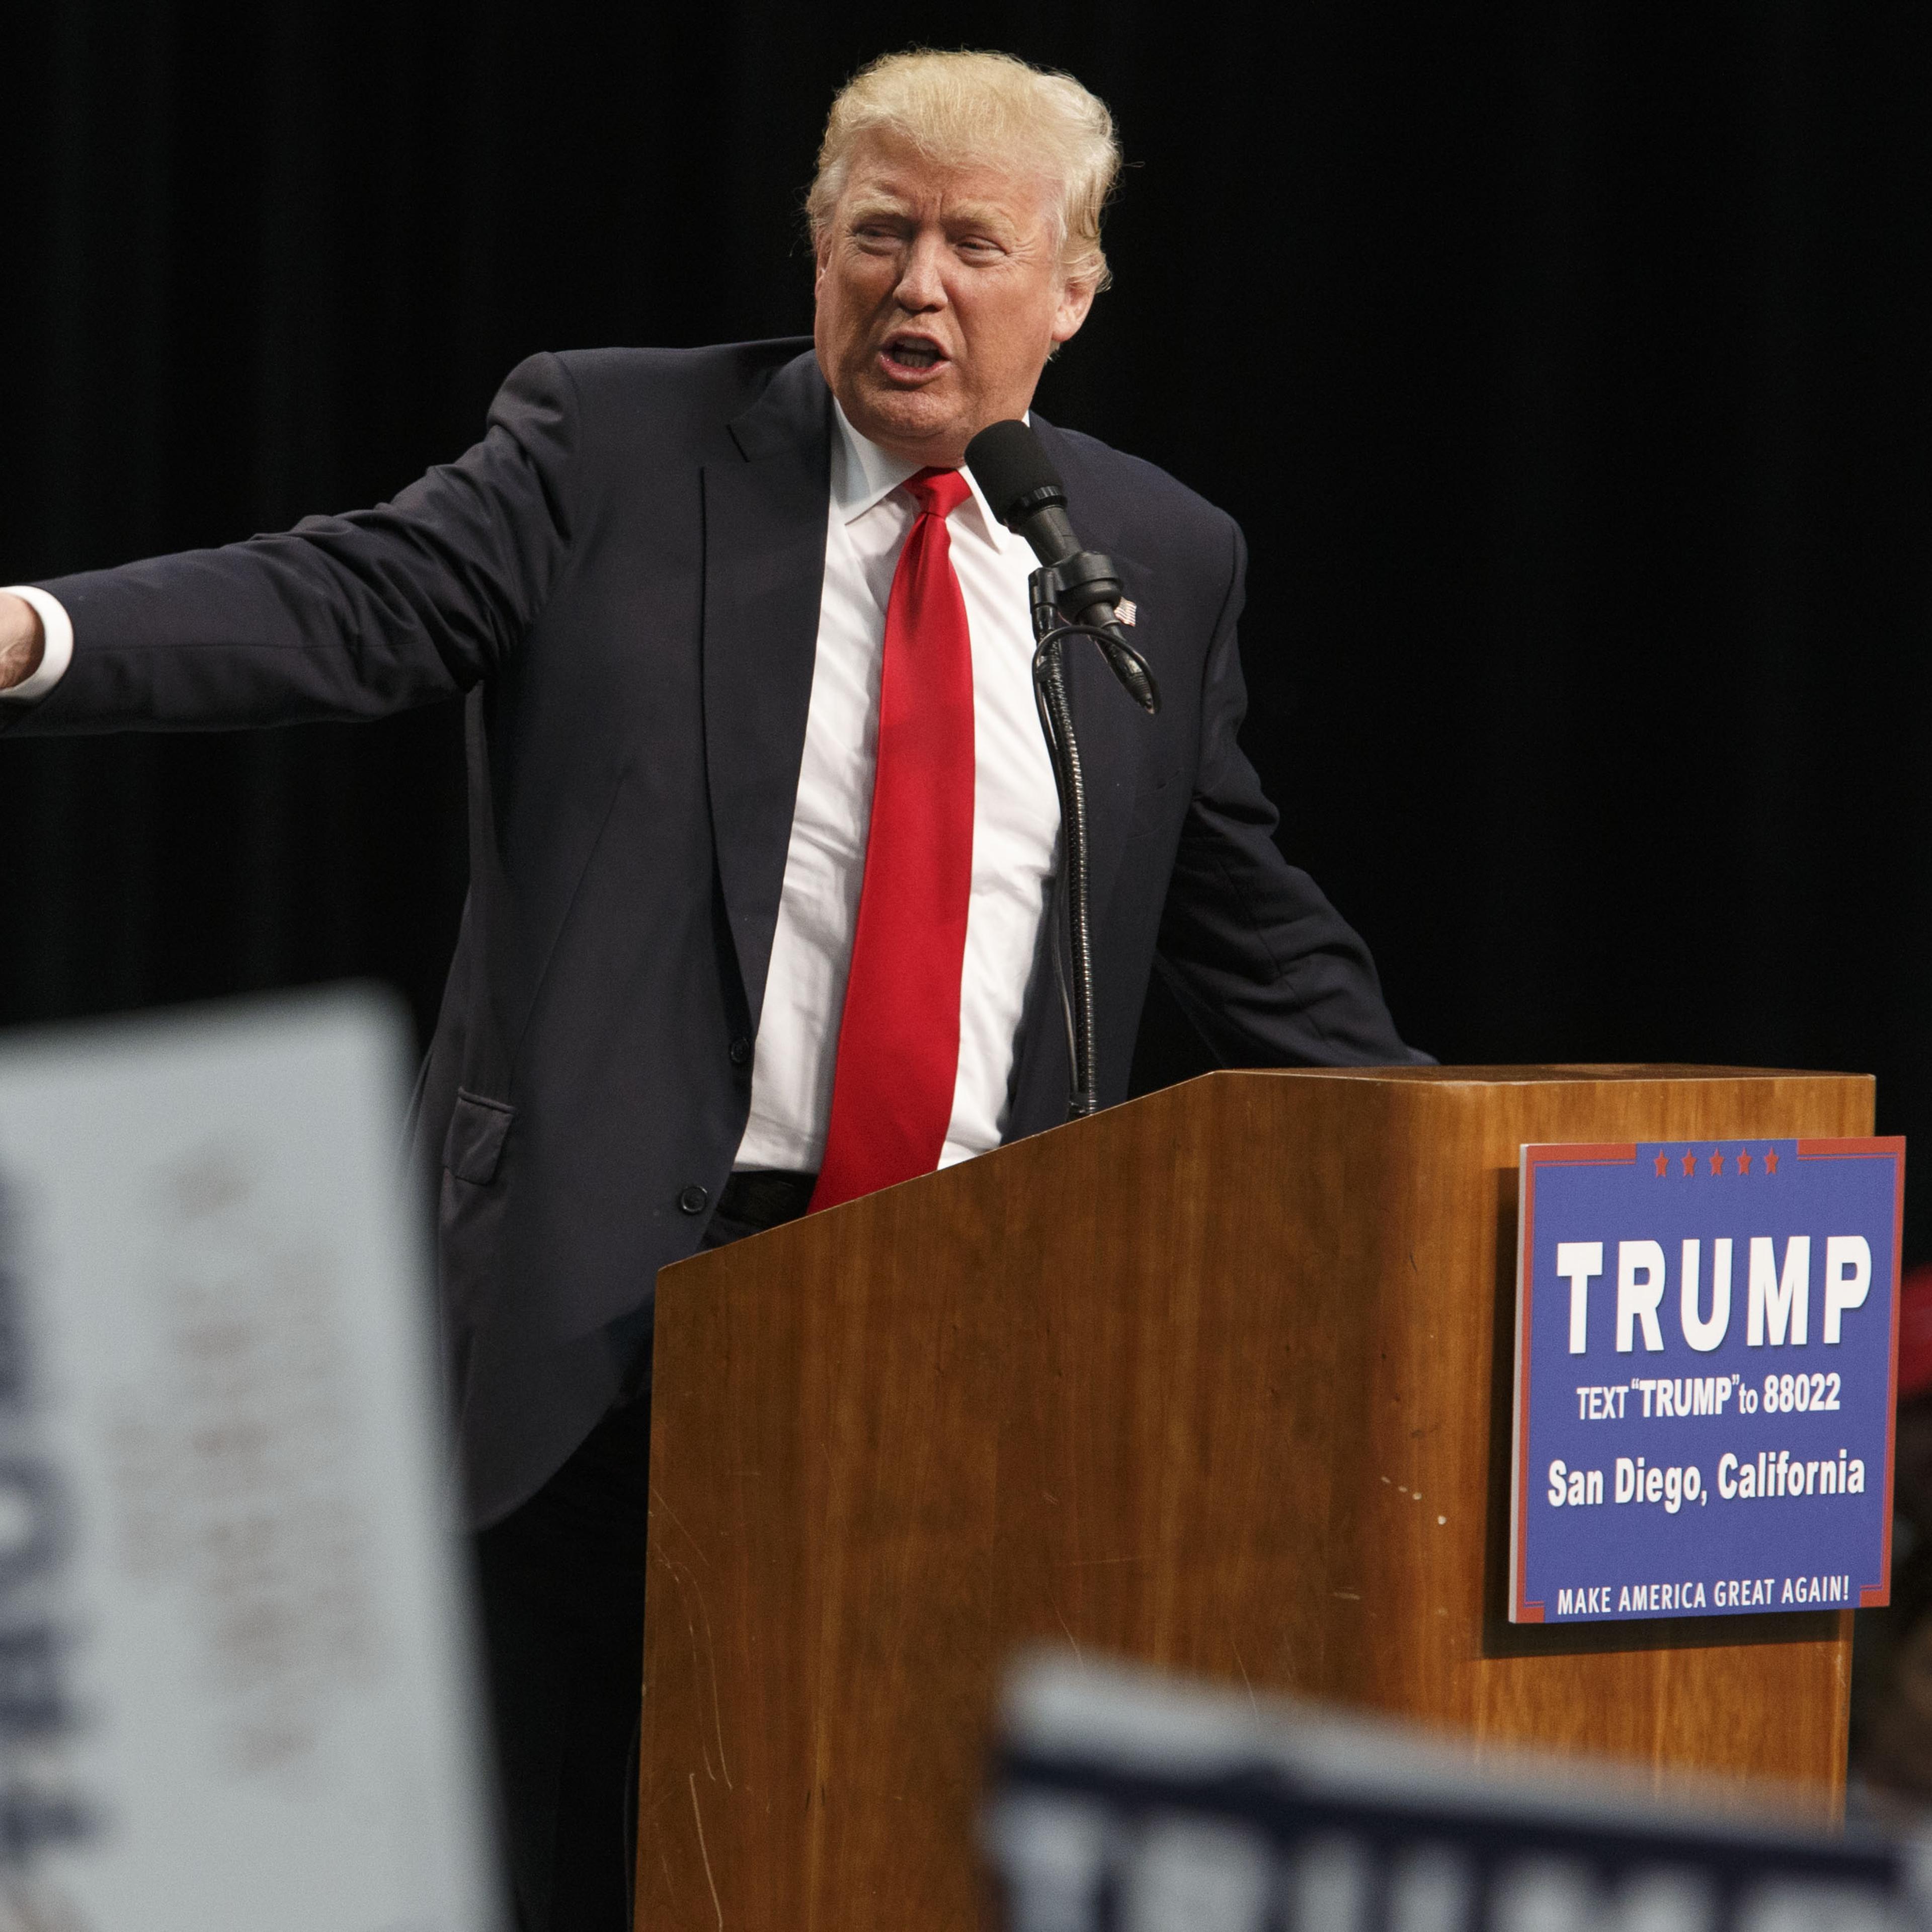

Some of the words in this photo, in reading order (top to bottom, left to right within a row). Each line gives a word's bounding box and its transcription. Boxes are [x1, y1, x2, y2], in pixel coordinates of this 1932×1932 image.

[1556, 1235, 1872, 1354] TRUMP
[1576, 1385, 1630, 1420] TEXT
[1738, 1383, 1758, 1415] to
[1763, 1372, 1841, 1414] 88022
[1548, 1459, 1603, 1507] San
[1615, 1457, 1707, 1514] Diego,
[1717, 1448, 1865, 1500] California
[1557, 1586, 1612, 1615] MAKE
[1618, 1582, 1707, 1612] AMERICA
[1714, 1578, 1775, 1607] GREAT
[1781, 1575, 1849, 1604] AGAIN!
